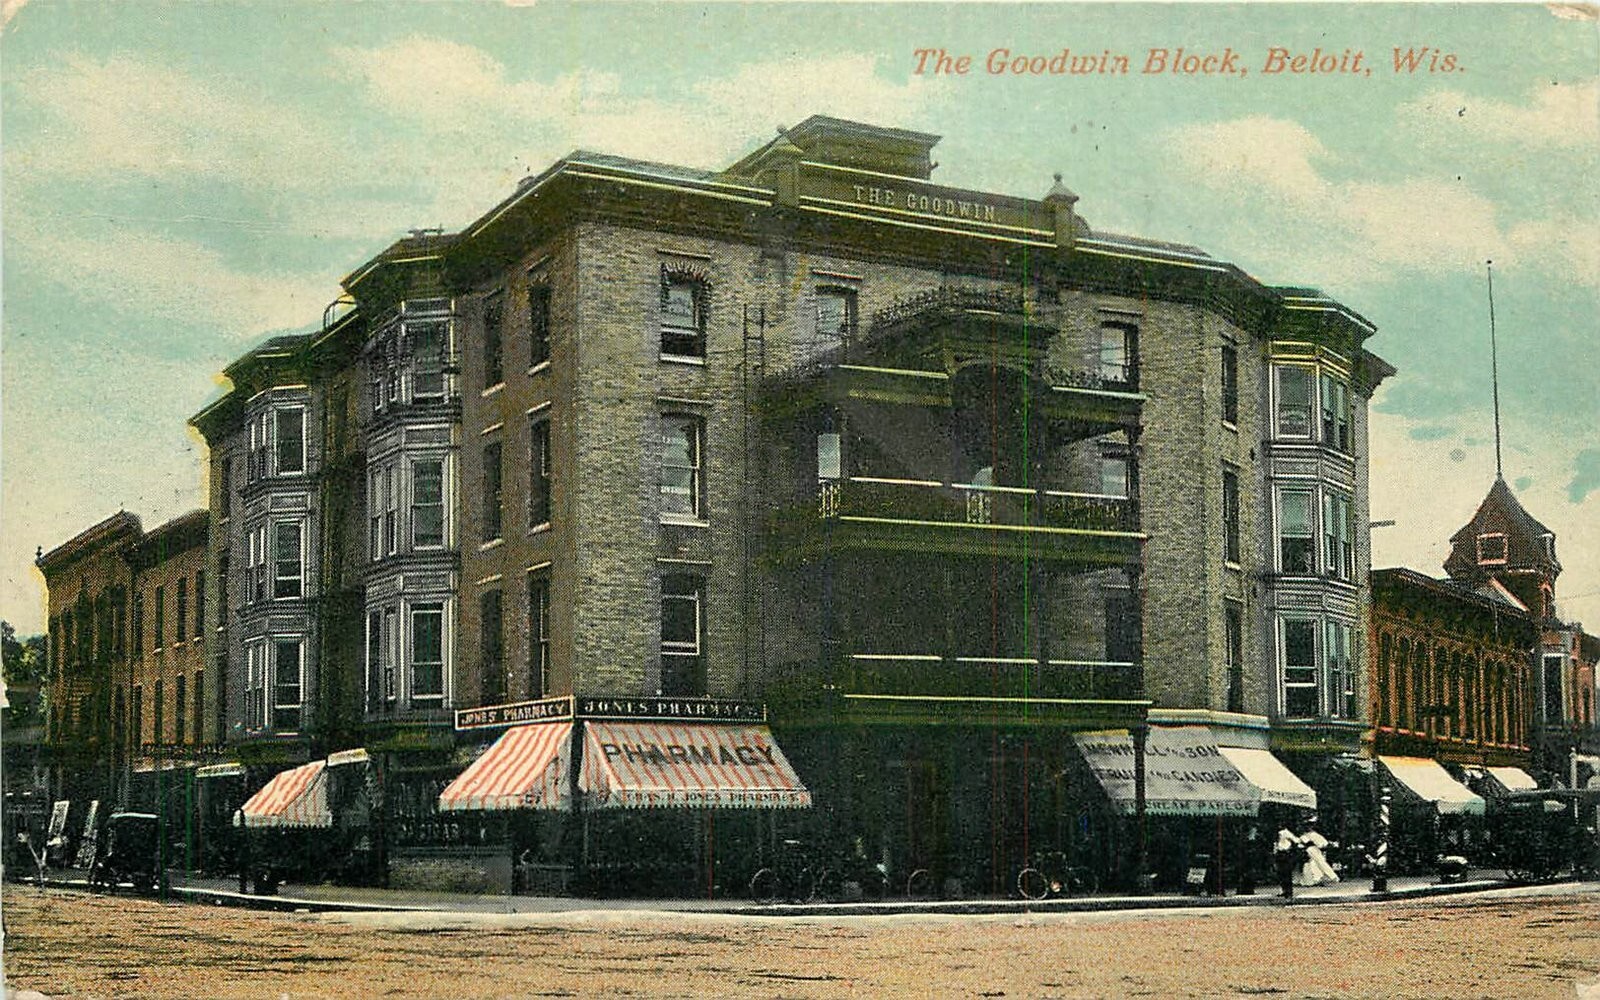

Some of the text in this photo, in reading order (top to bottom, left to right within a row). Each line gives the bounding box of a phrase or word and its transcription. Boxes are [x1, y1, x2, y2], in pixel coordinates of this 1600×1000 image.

[853, 185, 895, 205] THE
[461, 703, 565, 724] JONES PHARMACY
[584, 701, 648, 714] JONES
[601, 743, 776, 766] PHARMACY
[1185, 744, 1221, 759] SON
[1171, 769, 1241, 784] CANDIES
